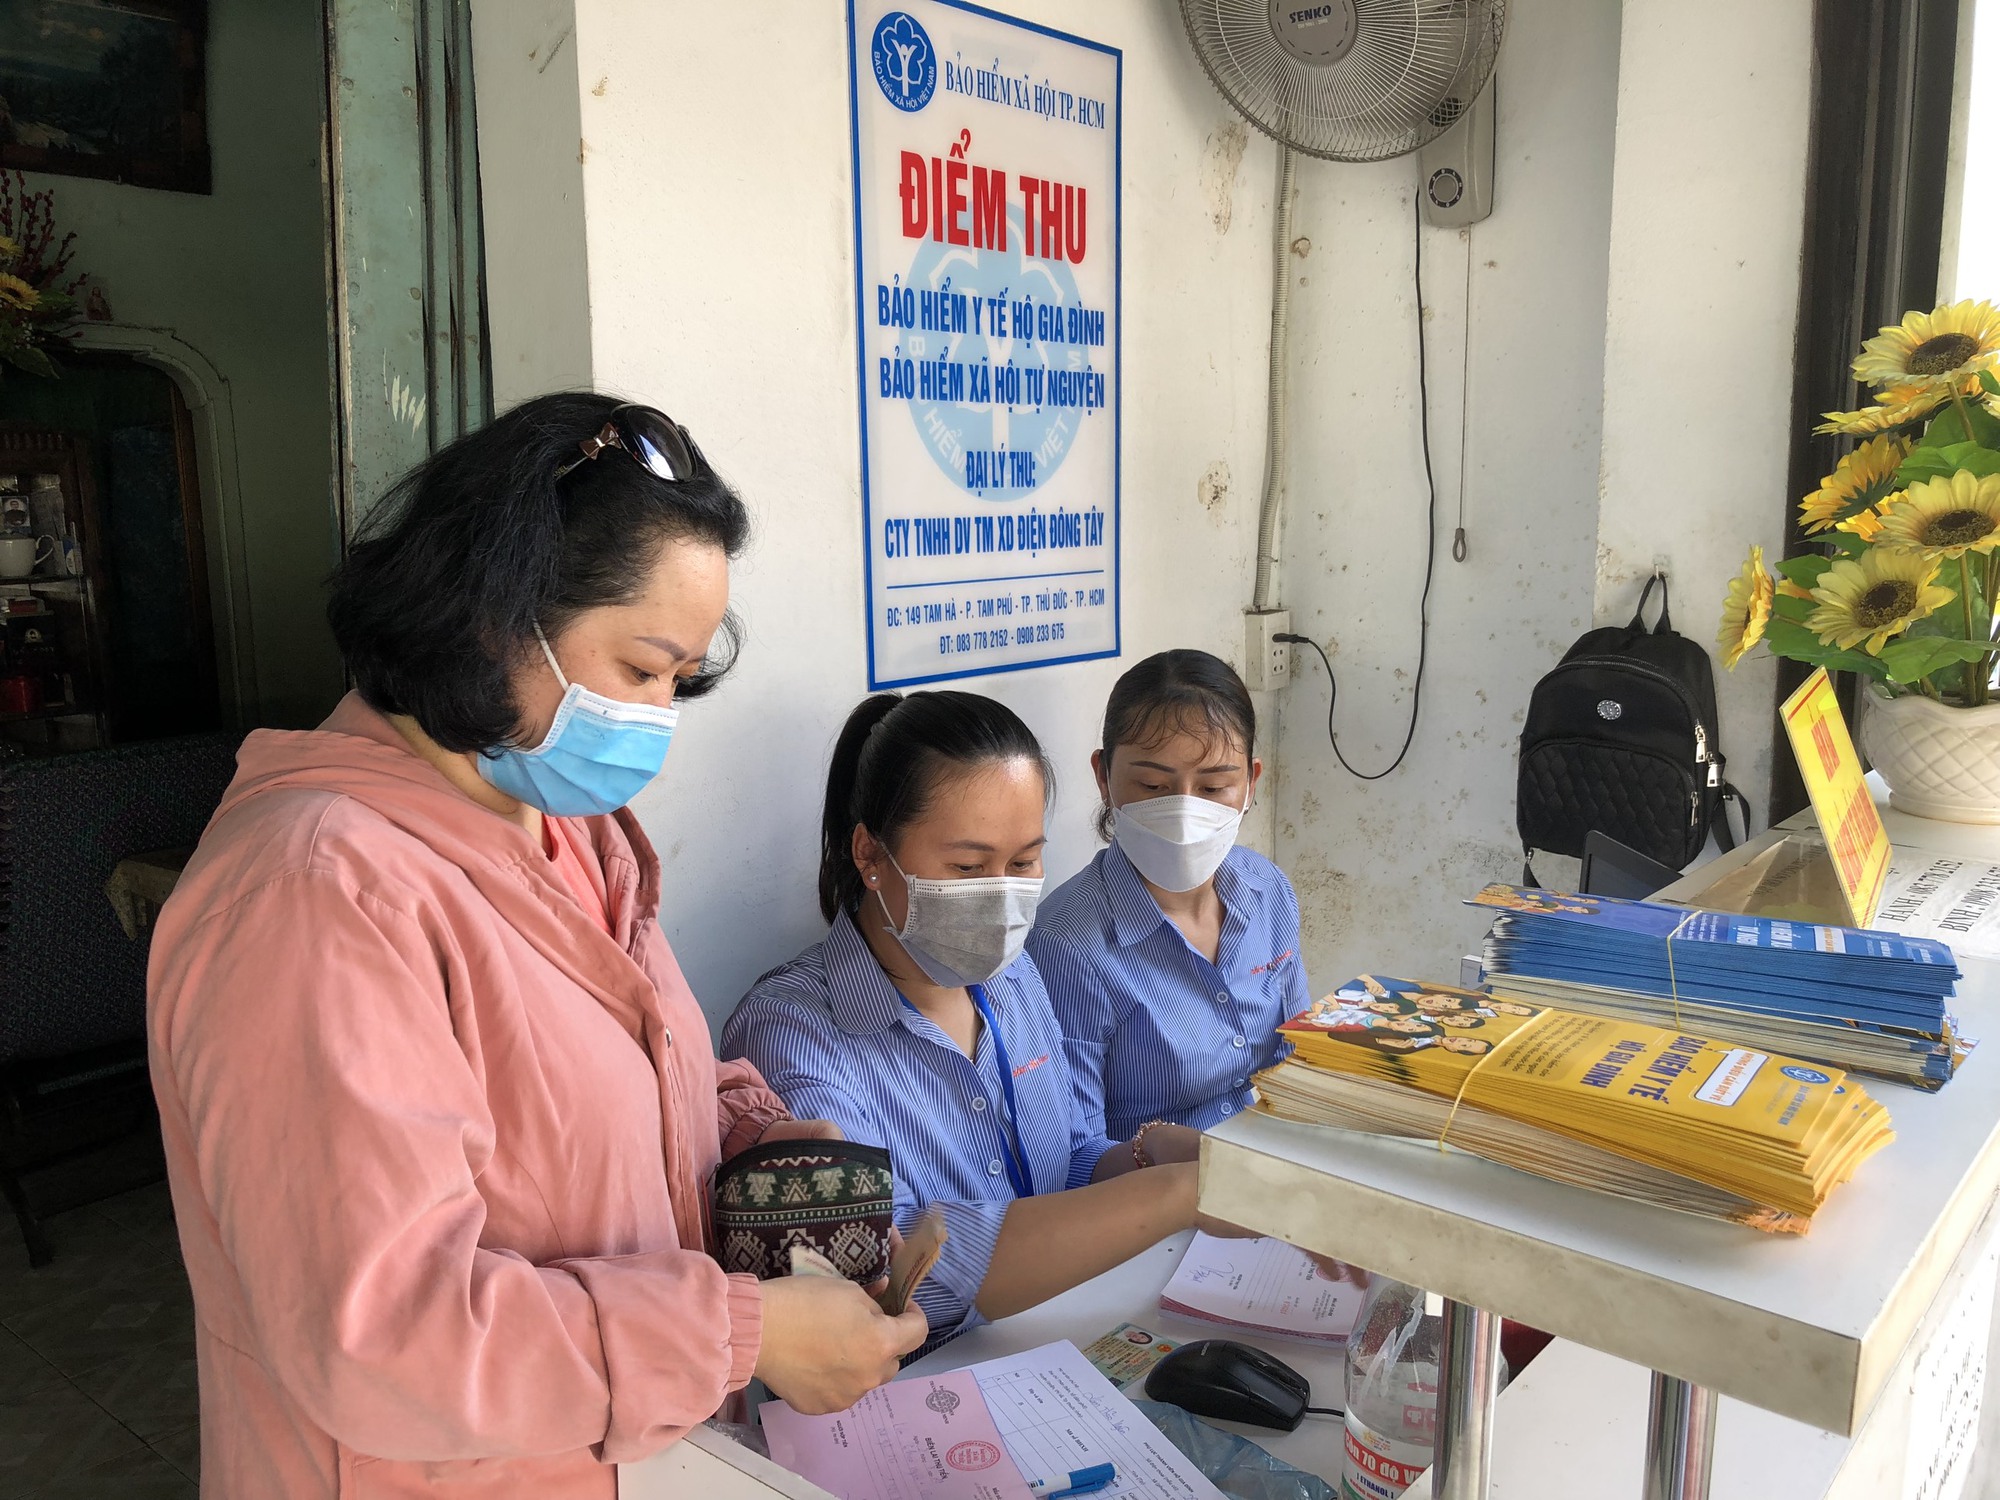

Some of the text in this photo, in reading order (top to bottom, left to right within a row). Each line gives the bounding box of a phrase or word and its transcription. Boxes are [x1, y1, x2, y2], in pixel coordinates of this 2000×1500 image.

[1289, 5, 1331, 24] SENKO
[927, 66, 935, 88] NAM
[945, 51, 973, 96] BẢO
[976, 57, 1011, 105] HIỂM
[1014, 75, 1031, 111] XÃ
[1034, 79, 1056, 121] HỘI
[1078, 97, 1105, 129] HCM
[899, 128, 1086, 264] ĐIỂM THU
[878, 273, 1105, 349] BẢO HIỂM Y TẾ HỘ GIA ĐÌNH
[880, 345, 914, 399] BẢO
[920, 346, 964, 402] HIỂM
[969, 356, 990, 403] XÃ
[995, 359, 1020, 413] HỘI
[1025, 364, 1045, 414] TỰ
[1048, 364, 1105, 416] NGUYỆN
[966, 443, 1036, 497] ĐẠI LÝ THU:
[885, 505, 1104, 559] CTY TNHH DV TM XD ĐIỆN ĐÔNG TÂY
[887, 607, 903, 627] ĐC:
[905, 605, 921, 625] 149
[924, 604, 942, 624] TAM
[945, 597, 957, 621] HÀ
[966, 601, 974, 619] P.
[977, 599, 994, 617] TAM
[997, 593, 1013, 616] PHÚ
[1021, 595, 1033, 614] TP.
[1036, 587, 1051, 612] THỦ
[1053, 588, 1068, 611] ĐỨC
[1076, 590, 1087, 607] TP.
[1089, 588, 1105, 606] HCM
[940, 635, 954, 655] ĐT:
[956, 632, 971, 652] 083
[974, 630, 988, 651] 778
[990, 628, 1008, 648] 2152
[1016, 626, 1034, 646] 0908
[1036, 624, 1050, 643] 233
[1052, 622, 1065, 641] 675
[1878, 897, 1924, 922] HẠNH
[1932, 908, 1982, 932] BÌNH
[1601, 1051, 1635, 1064] GIA
[1668, 1036, 1713, 1054] BẢO
[1580, 1062, 1624, 1088] ĐÌNH
[1647, 1051, 1697, 1077] HIỂM
[1628, 1083, 1669, 1104] TẾ
[1362, 1448, 1376, 1470] 70
[1380, 1461, 1399, 1483] độ
